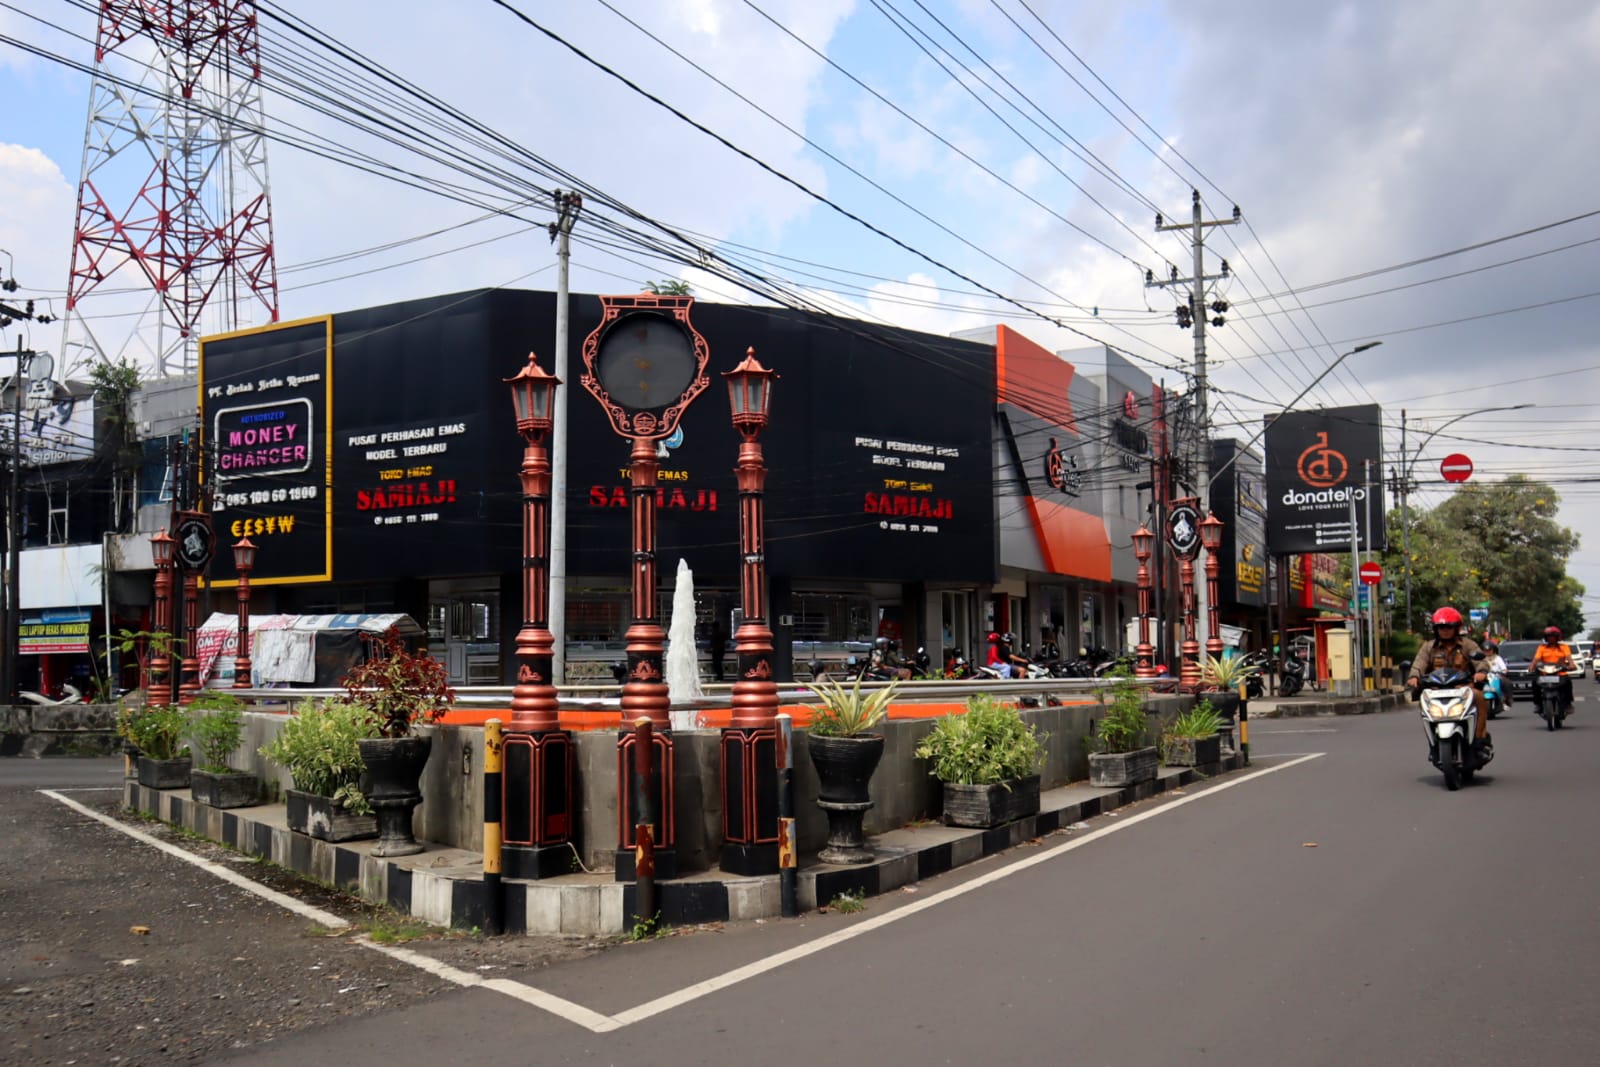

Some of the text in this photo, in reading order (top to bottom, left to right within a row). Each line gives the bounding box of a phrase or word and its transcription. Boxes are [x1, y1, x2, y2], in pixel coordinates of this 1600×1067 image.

[229, 424, 298, 447] MONEY
[348, 423, 466, 446] PUSAT PERHIASAN EMAS
[855, 437, 882, 449] PUSAT
[221, 446, 306, 470] CHANGER
[366, 442, 447, 460] MODEL TERBARU
[379, 469, 404, 480] TOKO
[658, 470, 688, 480] EMAS
[250, 490, 270, 504] 100
[356, 480, 456, 511] SAMIAJI
[589, 485, 718, 512] SAIAJI
[864, 492, 953, 519] SAMIAJI
